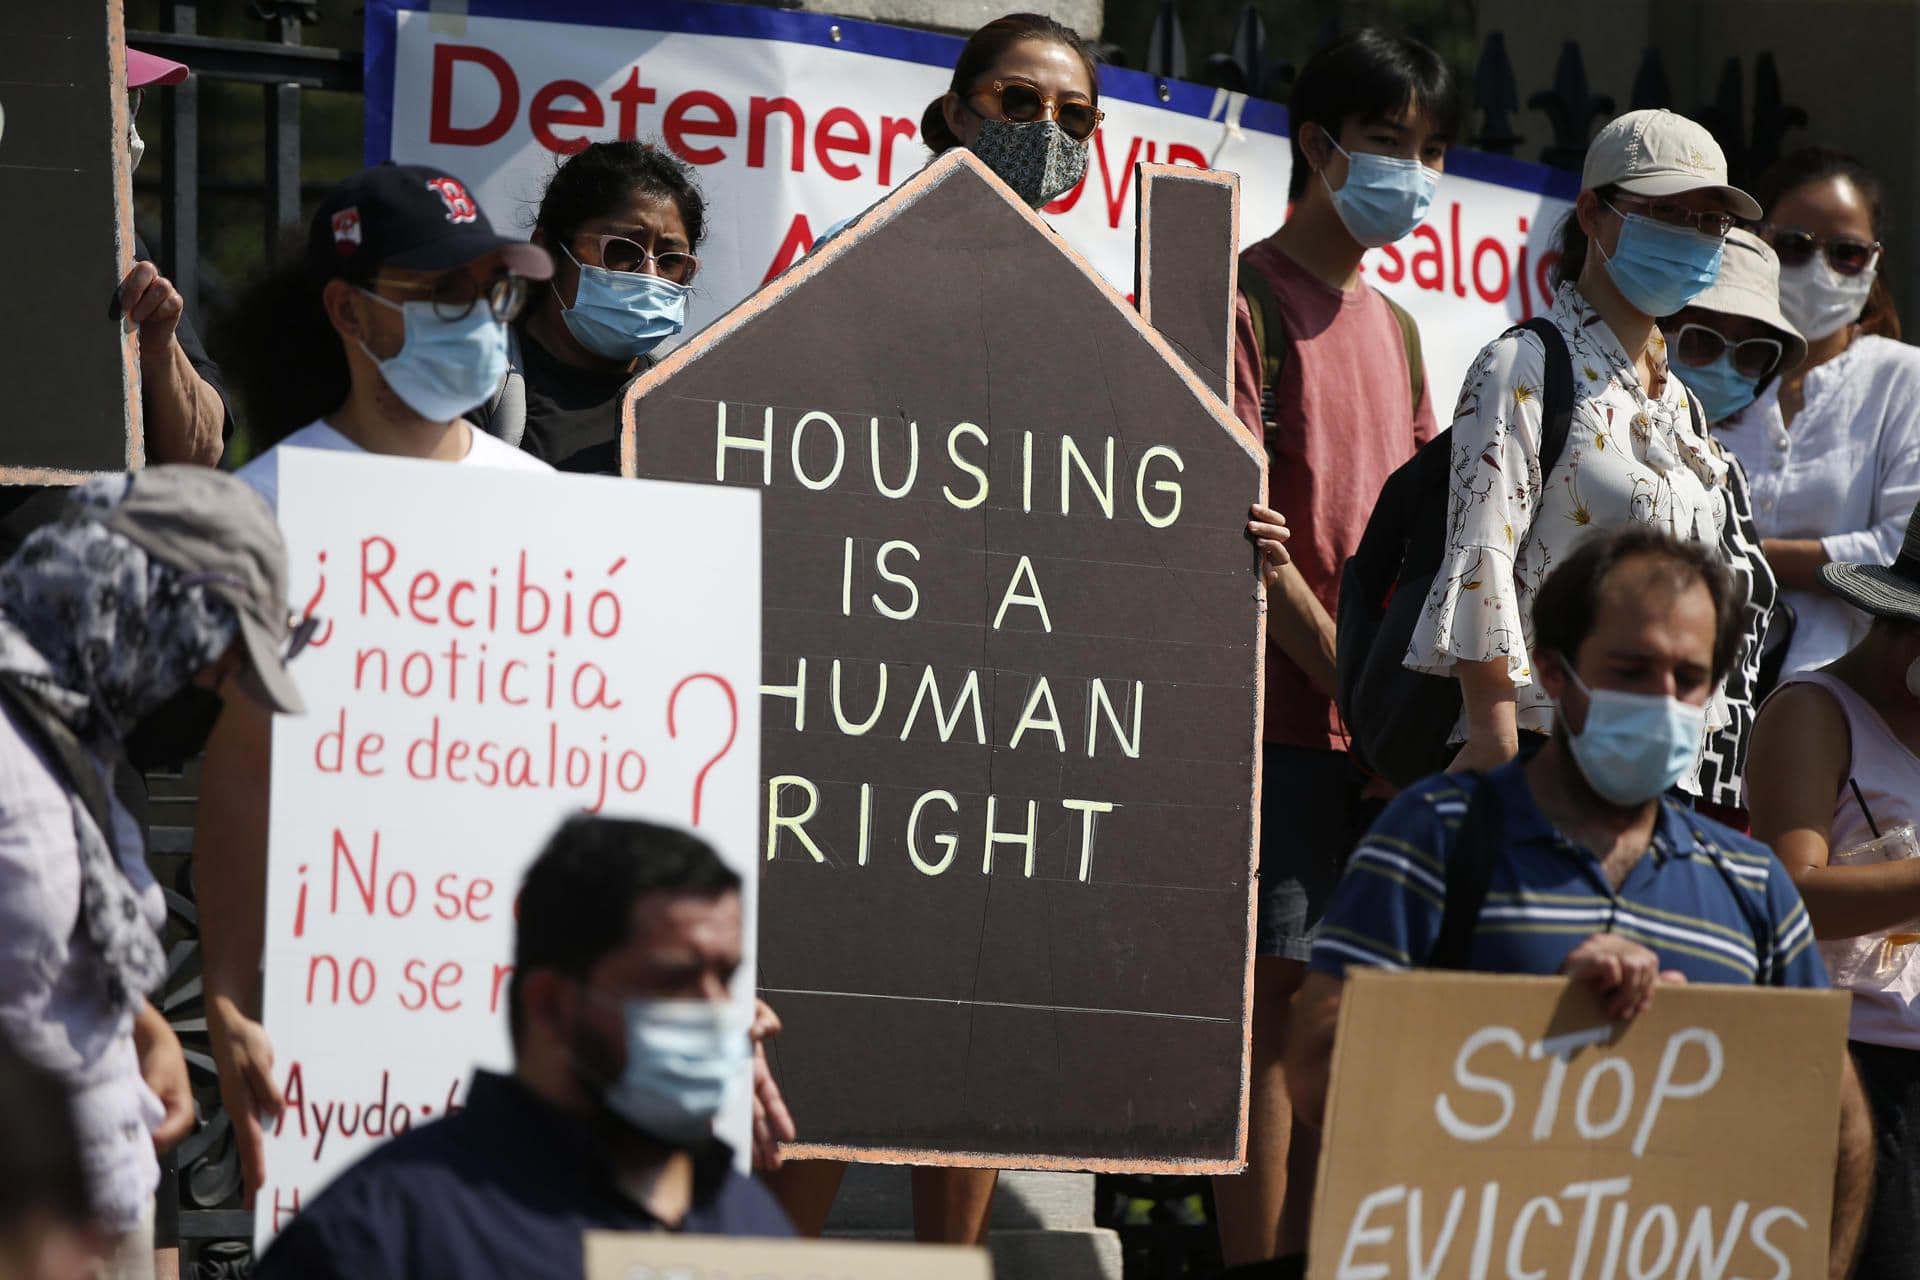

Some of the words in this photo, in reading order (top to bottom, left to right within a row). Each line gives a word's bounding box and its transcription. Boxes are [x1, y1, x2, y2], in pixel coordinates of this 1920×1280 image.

[428, 42, 917, 187] Detener
[425, 177, 477, 224] B
[716, 401, 1185, 528] HOUSING
[842, 537, 921, 621] IS
[992, 555, 1053, 633] A
[355, 639, 622, 710] noticia
[760, 657, 1144, 759] HUMAN
[314, 707, 385, 777] de
[406, 715, 647, 814] desalojo
[767, 774, 1115, 882] RIGHT
[433, 872, 495, 922] se
[305, 954, 377, 1006] no
[398, 958, 464, 1012] se
[1434, 1025, 1725, 1157] STOP
[1335, 1175, 1808, 1280] EVICTIONS
